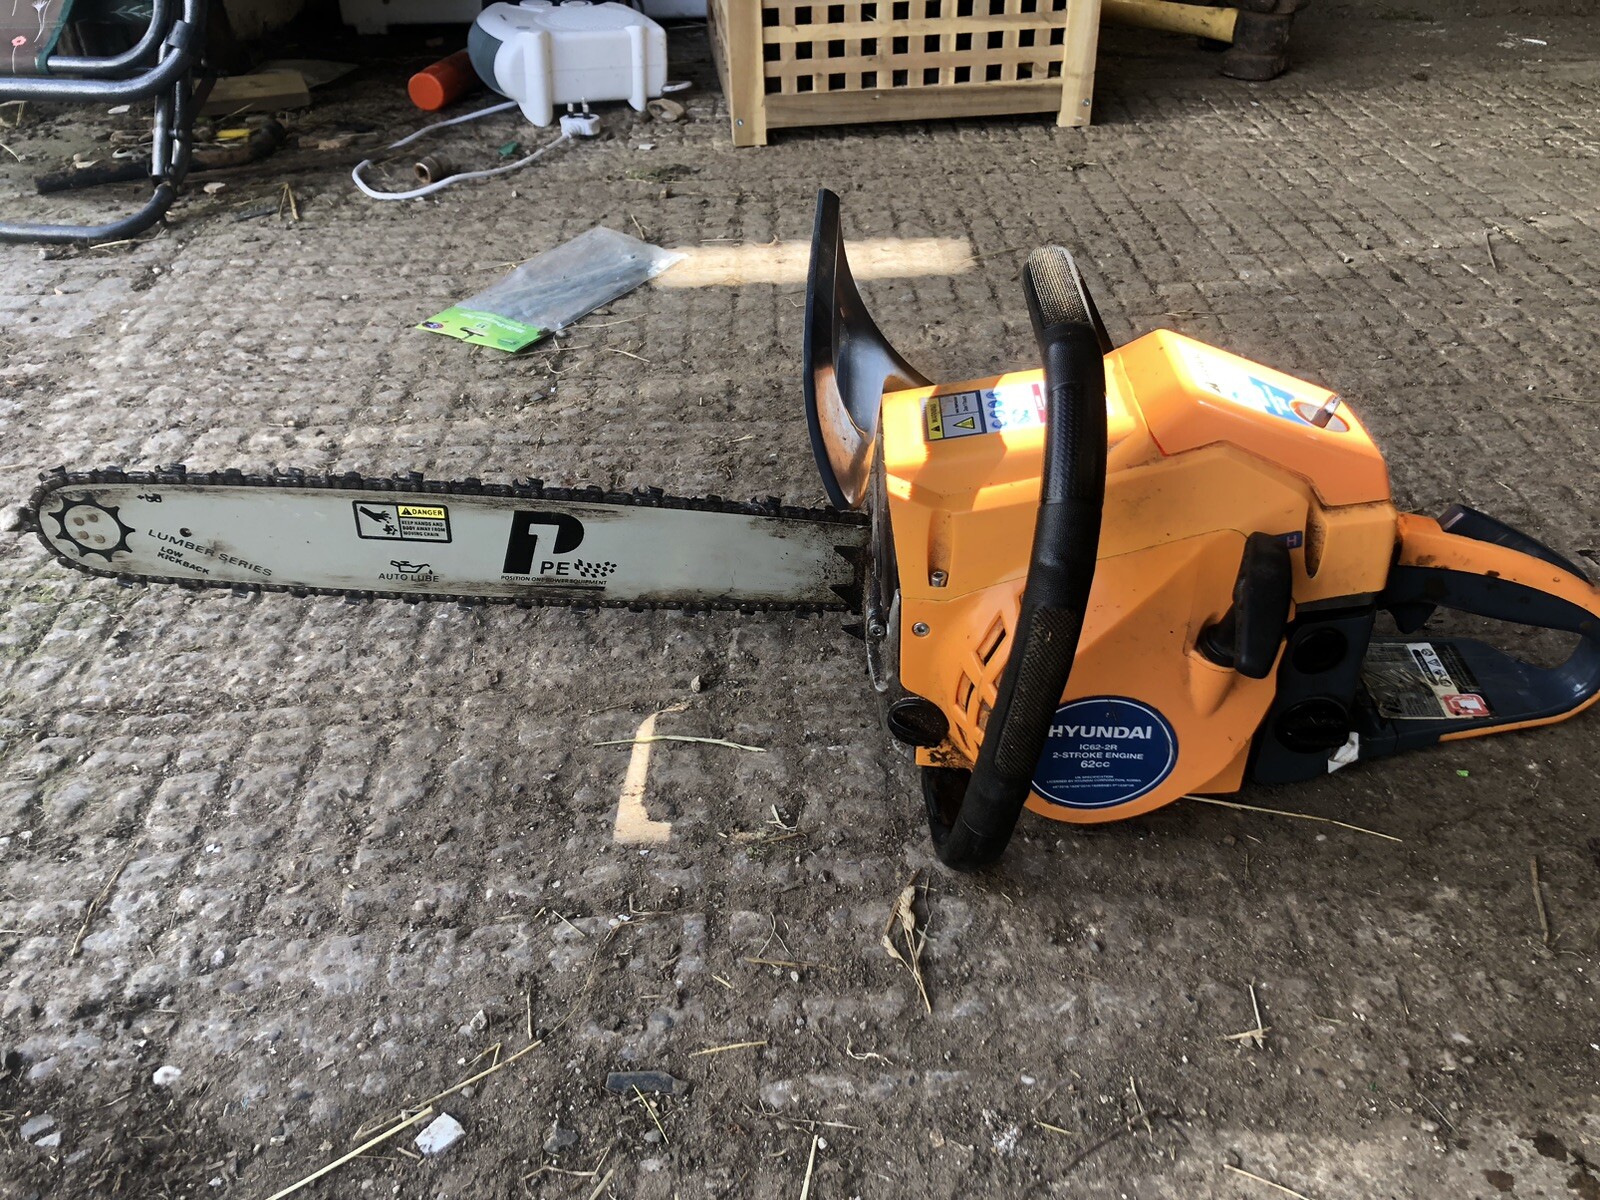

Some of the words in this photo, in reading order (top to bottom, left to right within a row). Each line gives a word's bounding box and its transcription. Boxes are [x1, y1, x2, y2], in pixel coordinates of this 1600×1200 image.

[411, 508, 443, 516] DANGER
[148, 528, 216, 557] LUMBER
[218, 553, 273, 577] SERIES
[160, 546, 184, 558] LOW
[157, 552, 210, 575] KICKBACK
[540, 561, 570, 575] PE
[378, 573, 408, 581] AUTO
[410, 574, 440, 582] LUBE
[1048, 725, 1152, 739] HYUNDAI
[1079, 743, 1118, 751] IC62-2R
[1105, 752, 1144, 760] ENGINE
[1080, 760, 1110, 768] 62cc
